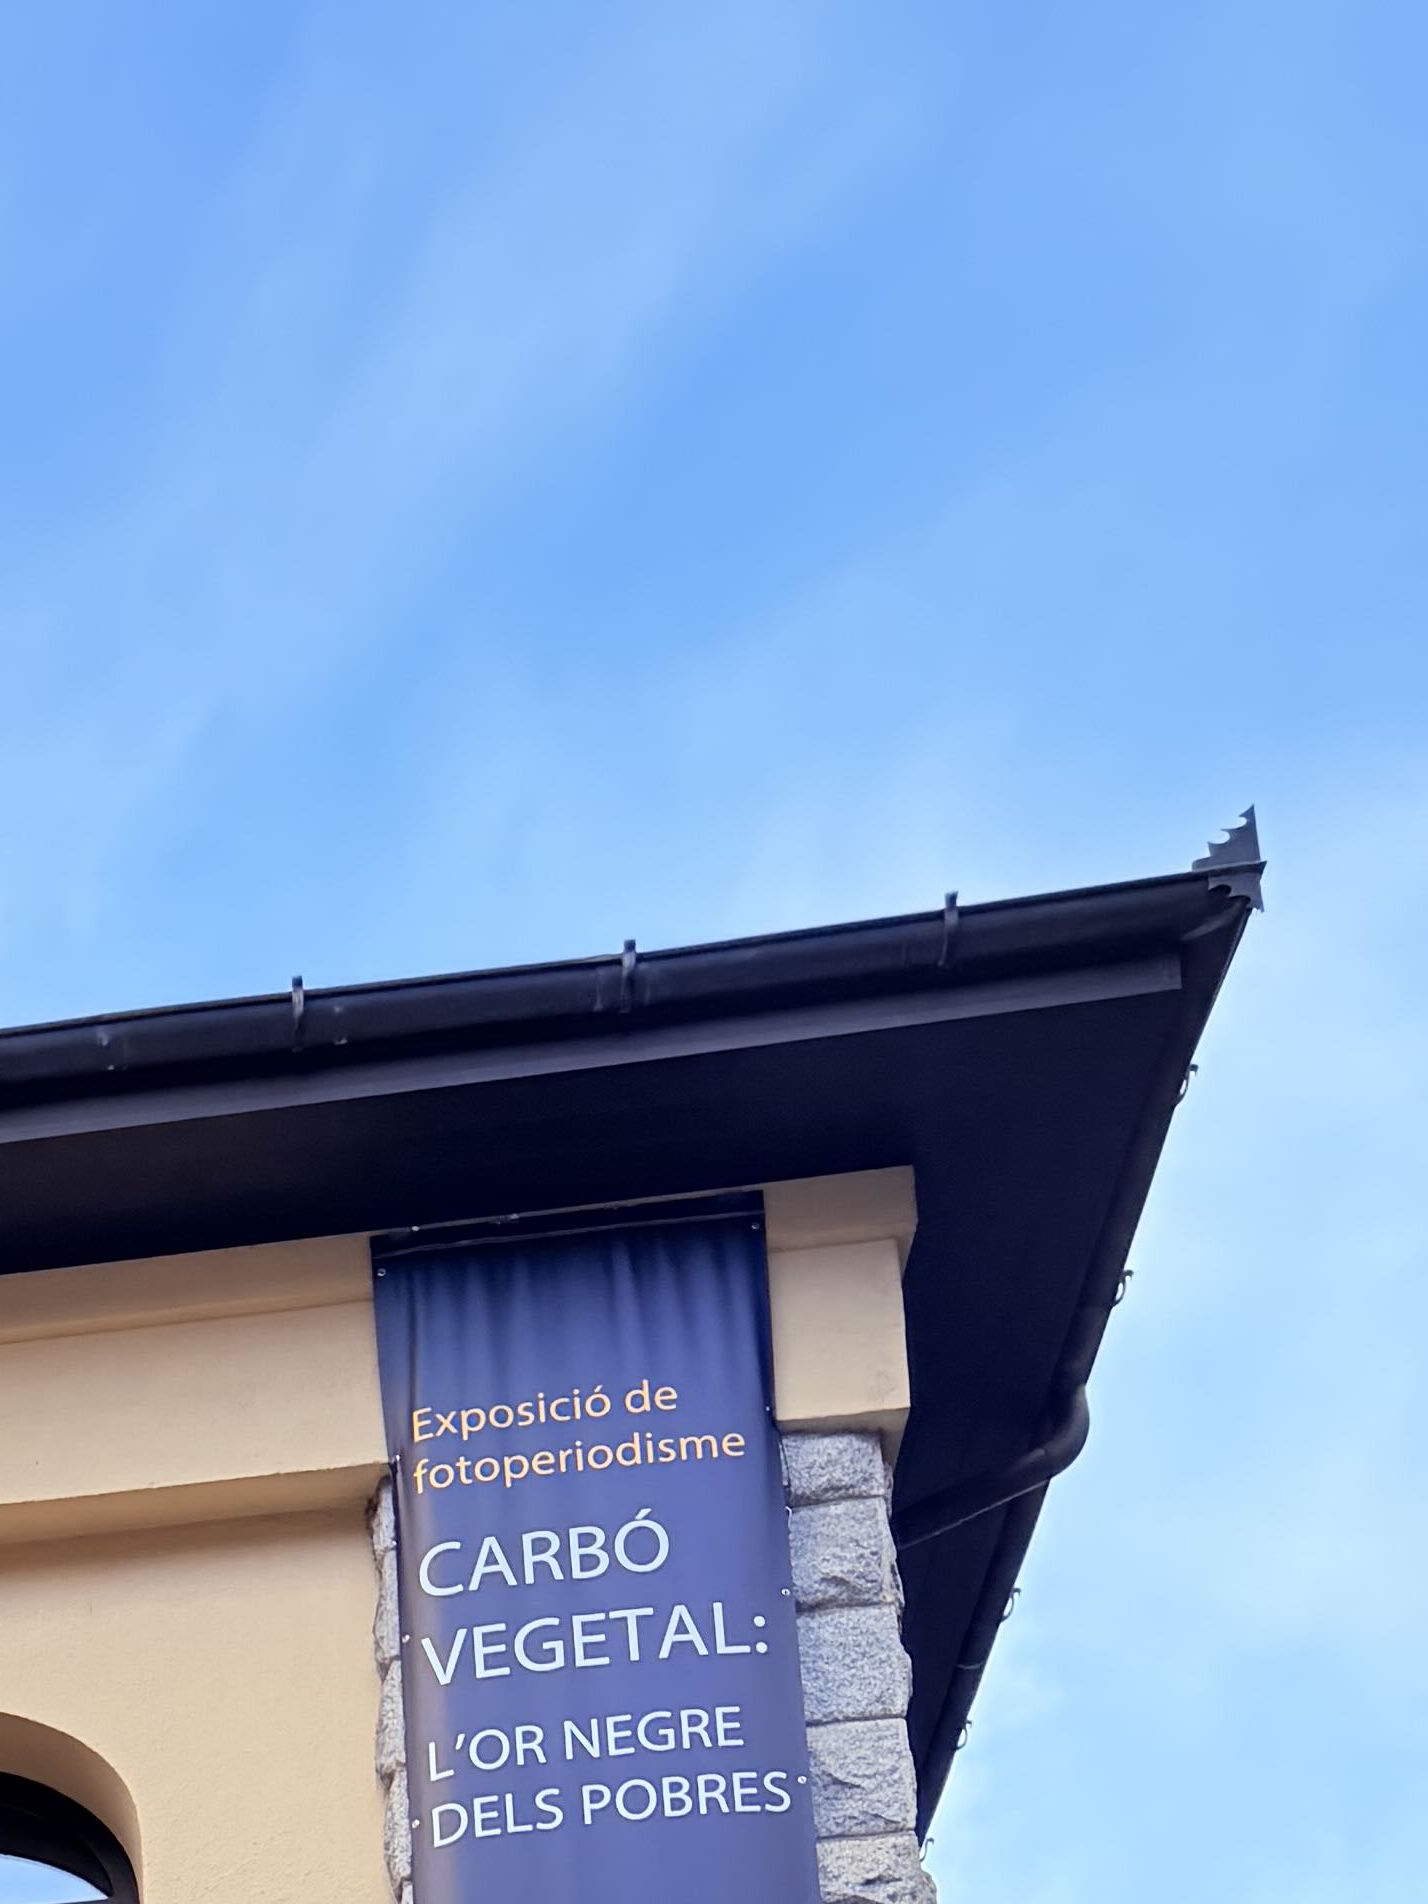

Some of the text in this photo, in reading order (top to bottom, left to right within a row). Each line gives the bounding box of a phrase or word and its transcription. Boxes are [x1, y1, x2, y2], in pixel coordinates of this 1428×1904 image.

[412, 1378, 678, 1442] Exposició de
[413, 1428, 746, 1494] fotoperiodisme
[419, 1508, 670, 1598] CARBÓ
[421, 1601, 768, 1686] VEGETAL:
[428, 1706, 745, 1782] L'OR NEGRE
[430, 1771, 792, 1849] DELS POBRES
